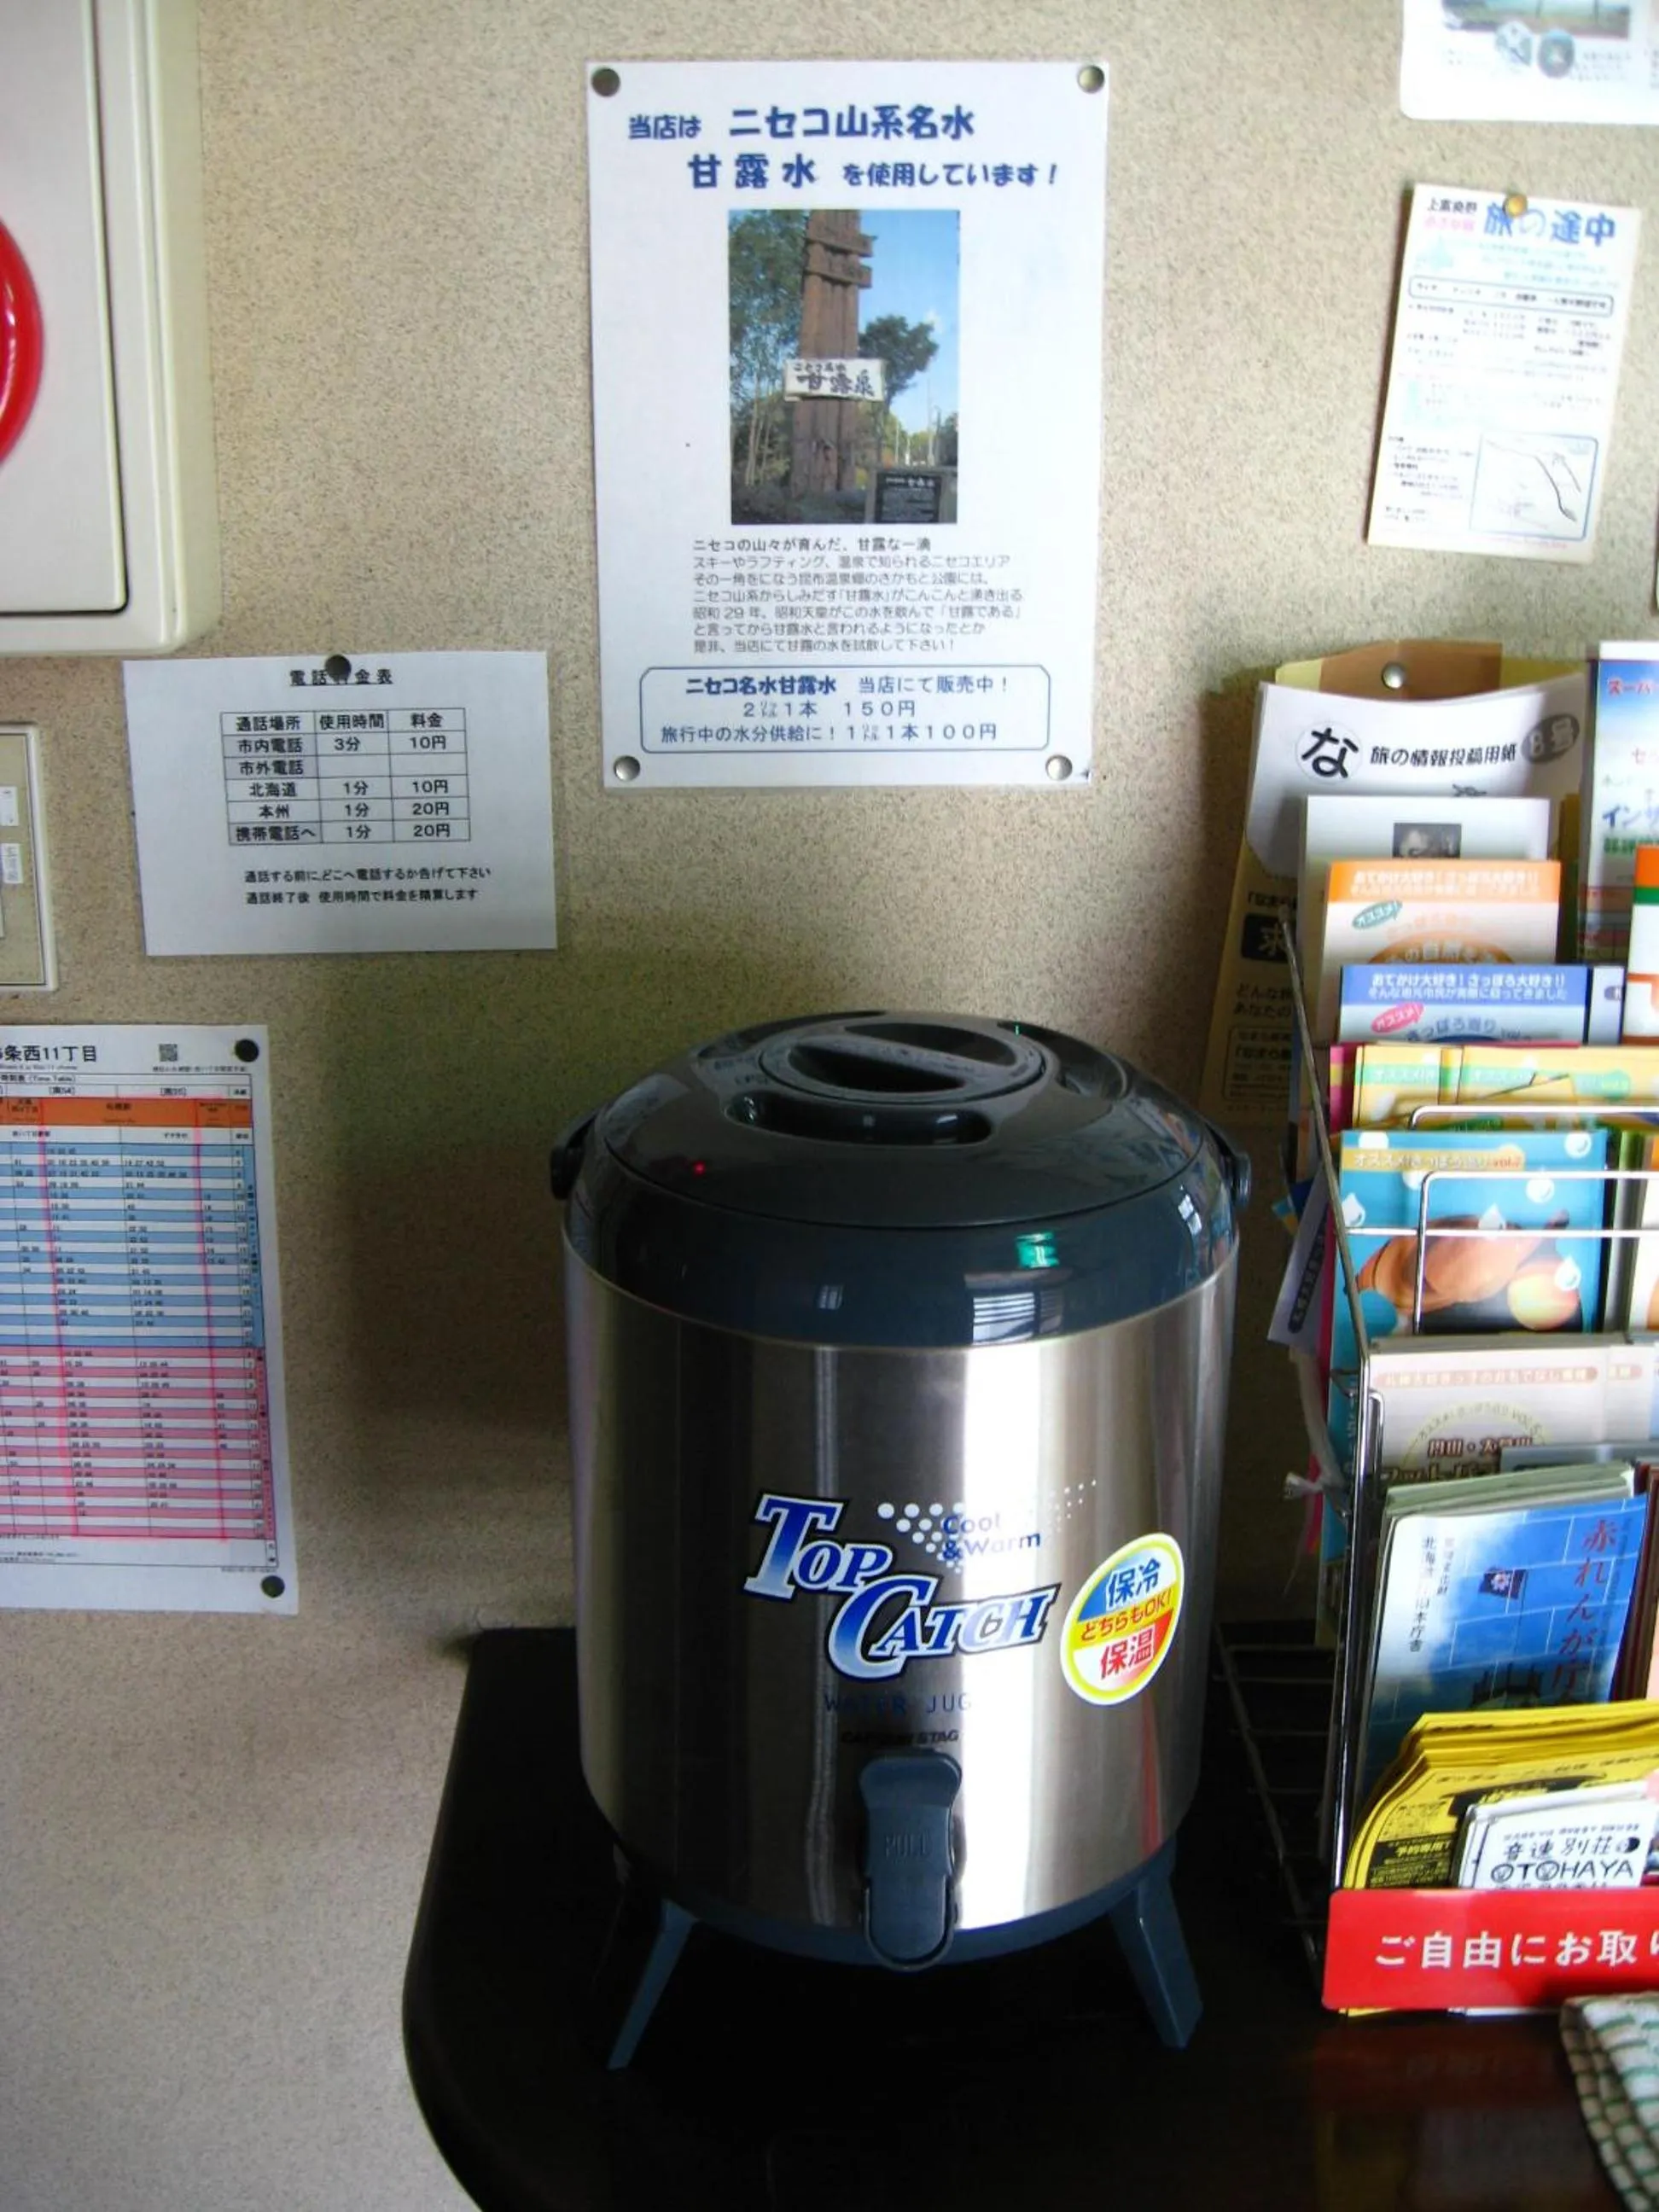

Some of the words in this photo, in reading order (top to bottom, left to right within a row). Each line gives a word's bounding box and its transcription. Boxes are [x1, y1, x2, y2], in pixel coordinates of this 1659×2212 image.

[628, 114, 702, 141] 当店は
[729, 104, 975, 141] ニセコ山系名水
[688, 153, 818, 189] 甘露水
[290, 669, 393, 684] 電話金表
[686, 676, 837, 696] ニセコ名水甘露水
[236, 716, 300, 732] 通話場所
[319, 713, 385, 730] 使用時間
[410, 712, 444, 728] 料金
[238, 738, 303, 754] 市内電話
[335, 736, 360, 752] 3分
[410, 736, 446, 750] 10円
[1301, 727, 1359, 779] な
[1370, 742, 1517, 767] 旅の情報投稿用紙
[240, 760, 304, 776] 市外電話
[249, 782, 297, 798] 北海道
[344, 781, 368, 795] 1分
[412, 779, 449, 795] 10円
[259, 805, 290, 819] 本州
[345, 802, 370, 818] 1分
[413, 801, 450, 817] 20円
[236, 826, 317, 841] 携帯電話へ
[346, 824, 370, 840] 1分
[414, 824, 451, 839] 20円
[246, 891, 310, 905] 通話終了後
[0, 1045, 97, 1062] 条西11丁目
[1107, 1560, 1160, 1609] 保冷
[1100, 1628, 1153, 1679] 保温
[926, 1693, 971, 1714] JUG
[1491, 1860, 1634, 1883] OTOHAYA
